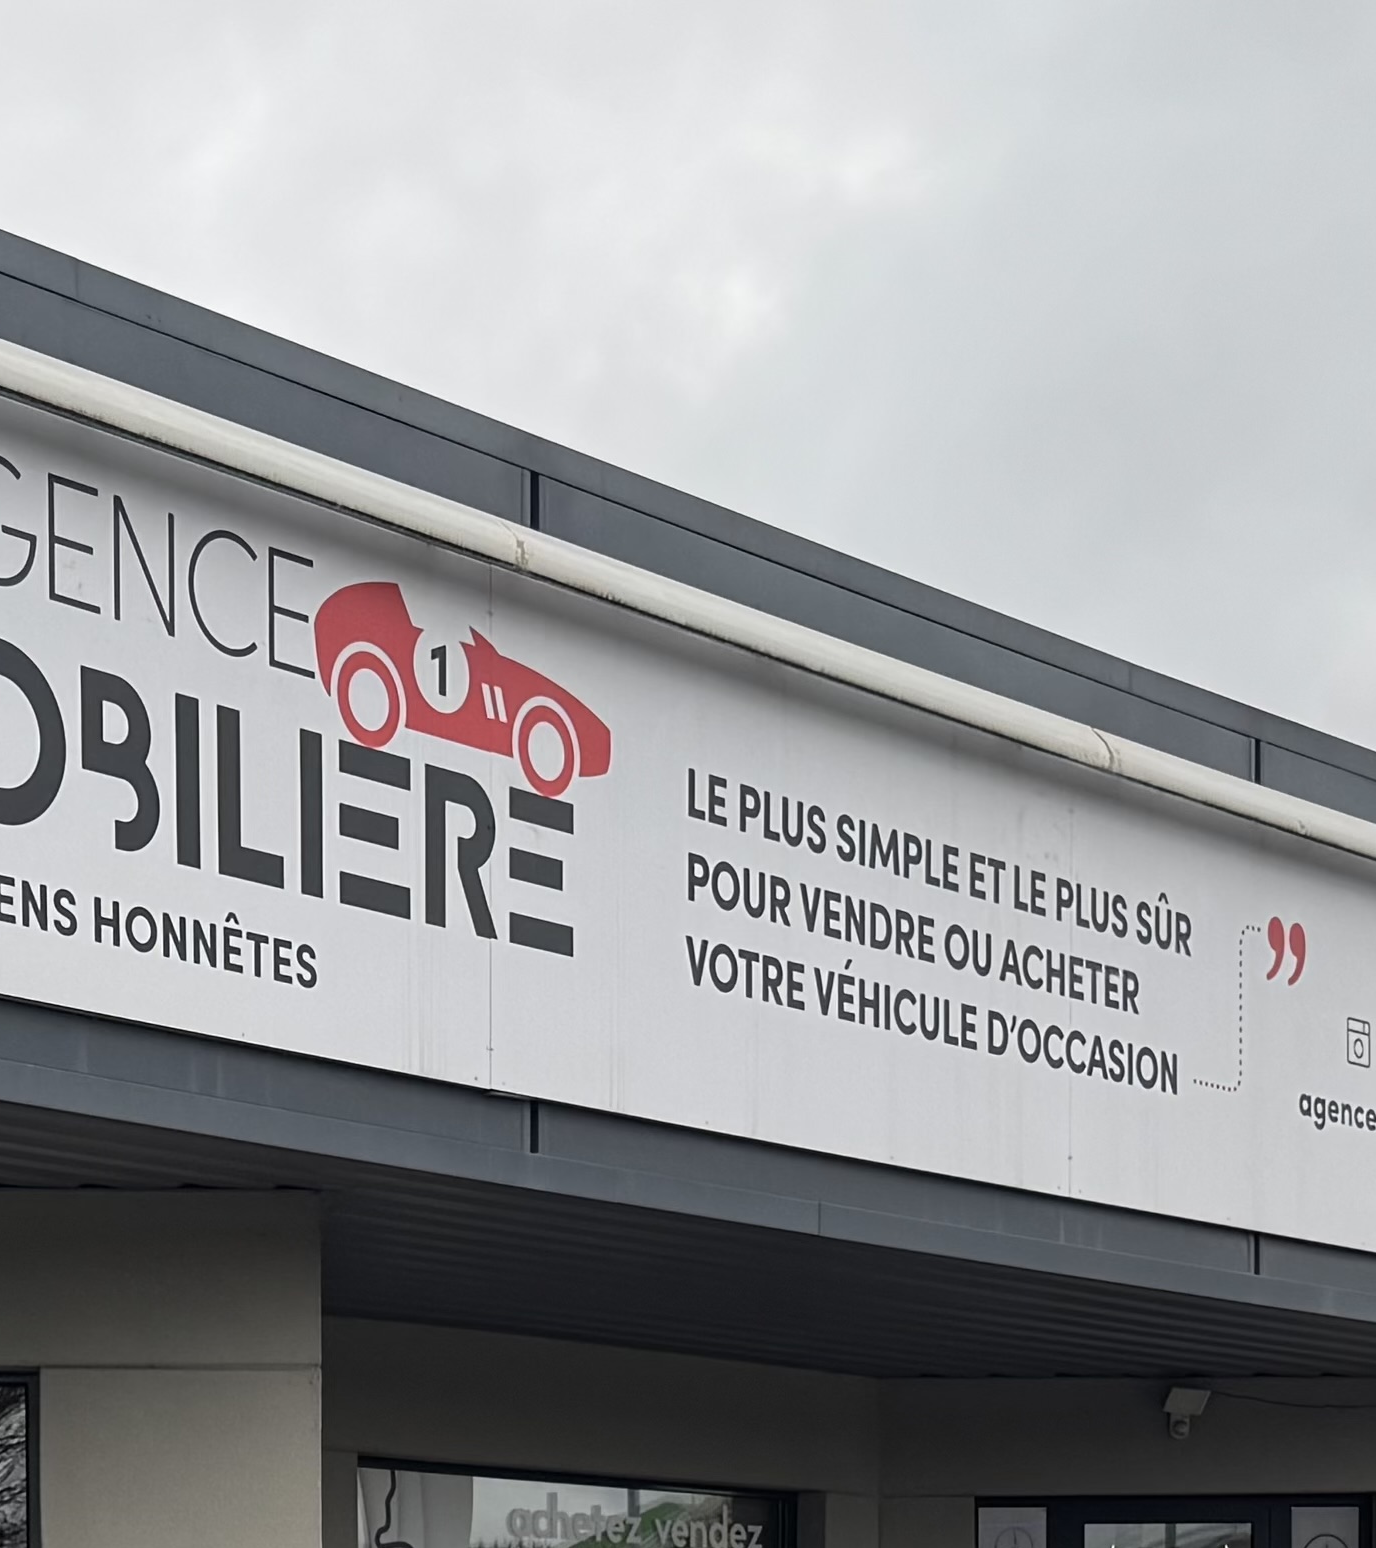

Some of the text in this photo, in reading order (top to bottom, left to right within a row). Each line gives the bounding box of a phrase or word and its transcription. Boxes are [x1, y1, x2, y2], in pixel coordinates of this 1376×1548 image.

[687, 767, 1194, 958] LE PLUS SIMPLE ET LE PLUS SÛR
[687, 851, 1141, 1016] POUR VENDRE OU ACHETER
[93, 897, 319, 990] HONNÊTES
[685, 935, 1179, 1096] VOTRE VÉHICULE D'OCCASION
[506, 1491, 642, 1545] achetez
